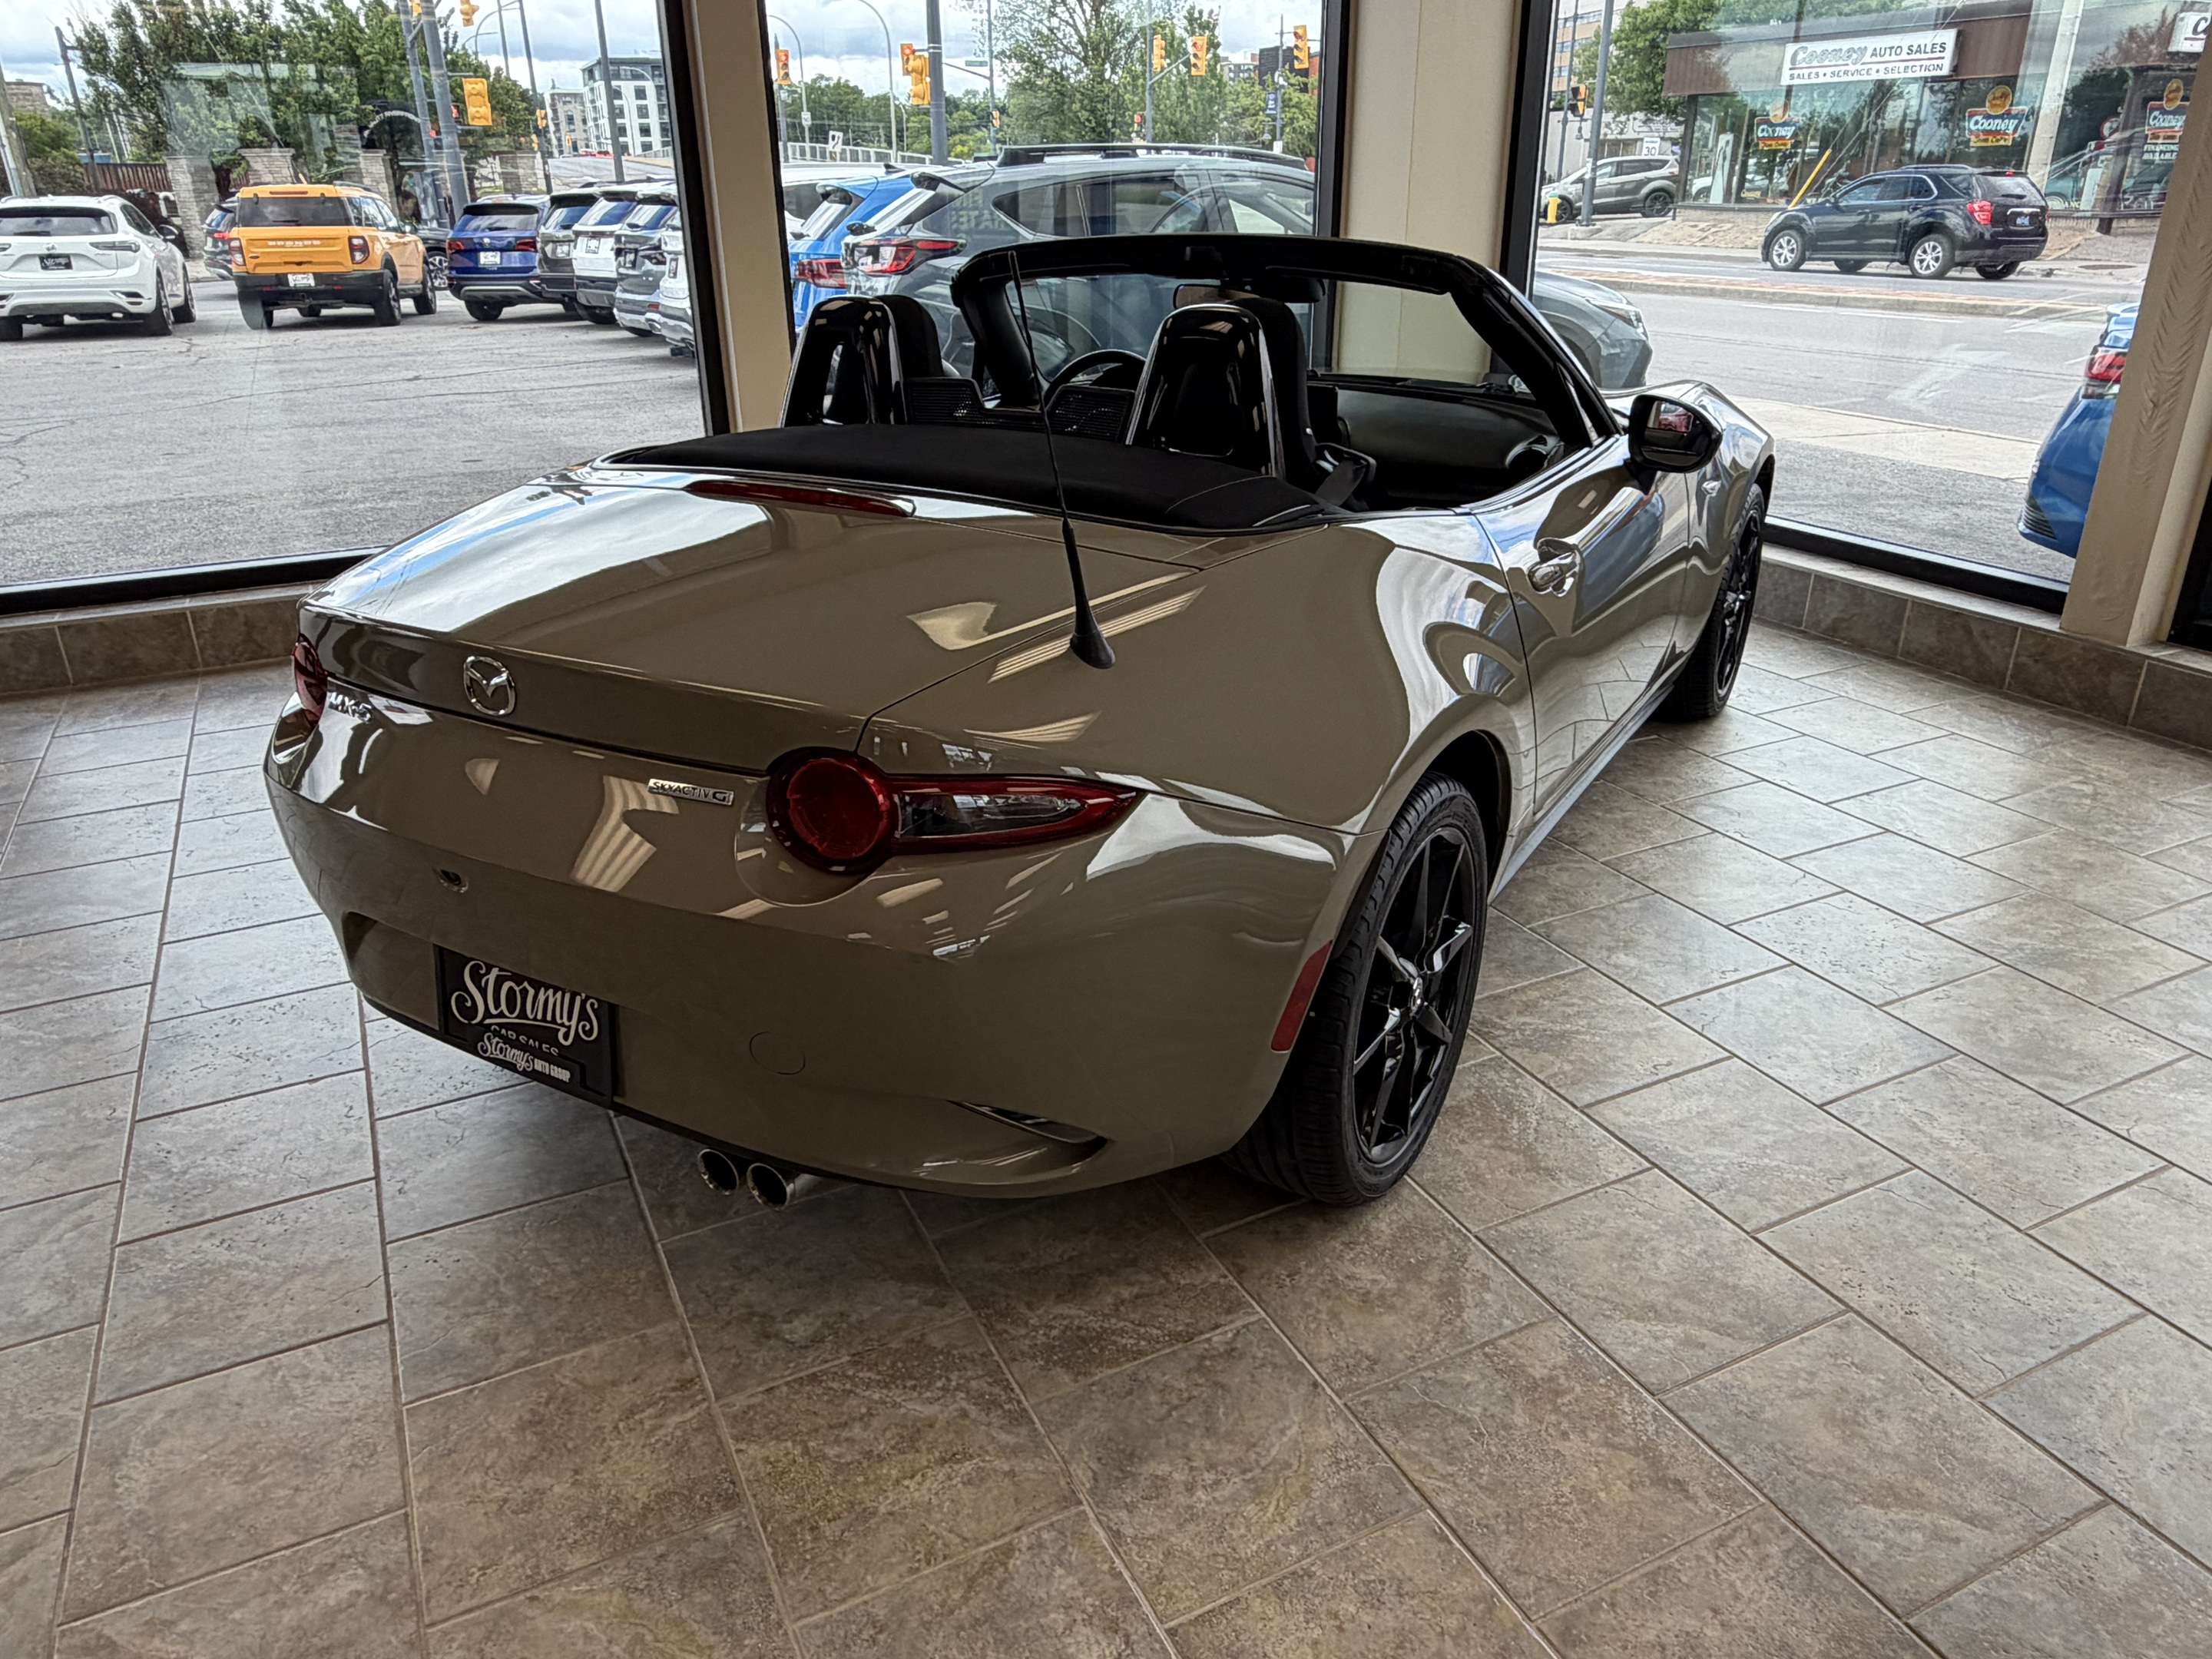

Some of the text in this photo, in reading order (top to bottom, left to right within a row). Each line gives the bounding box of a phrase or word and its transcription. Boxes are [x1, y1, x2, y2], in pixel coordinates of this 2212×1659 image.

[1790, 42, 1947, 65] Cooney AUTO SALES
[1789, 64, 1944, 81] SALES SERVICE SELECTION
[1969, 115, 2019, 133] Cooney
[1644, 146, 1657, 156] 30
[451, 960, 598, 1046] Stormy's
[477, 1032, 534, 1072] Stormy's
